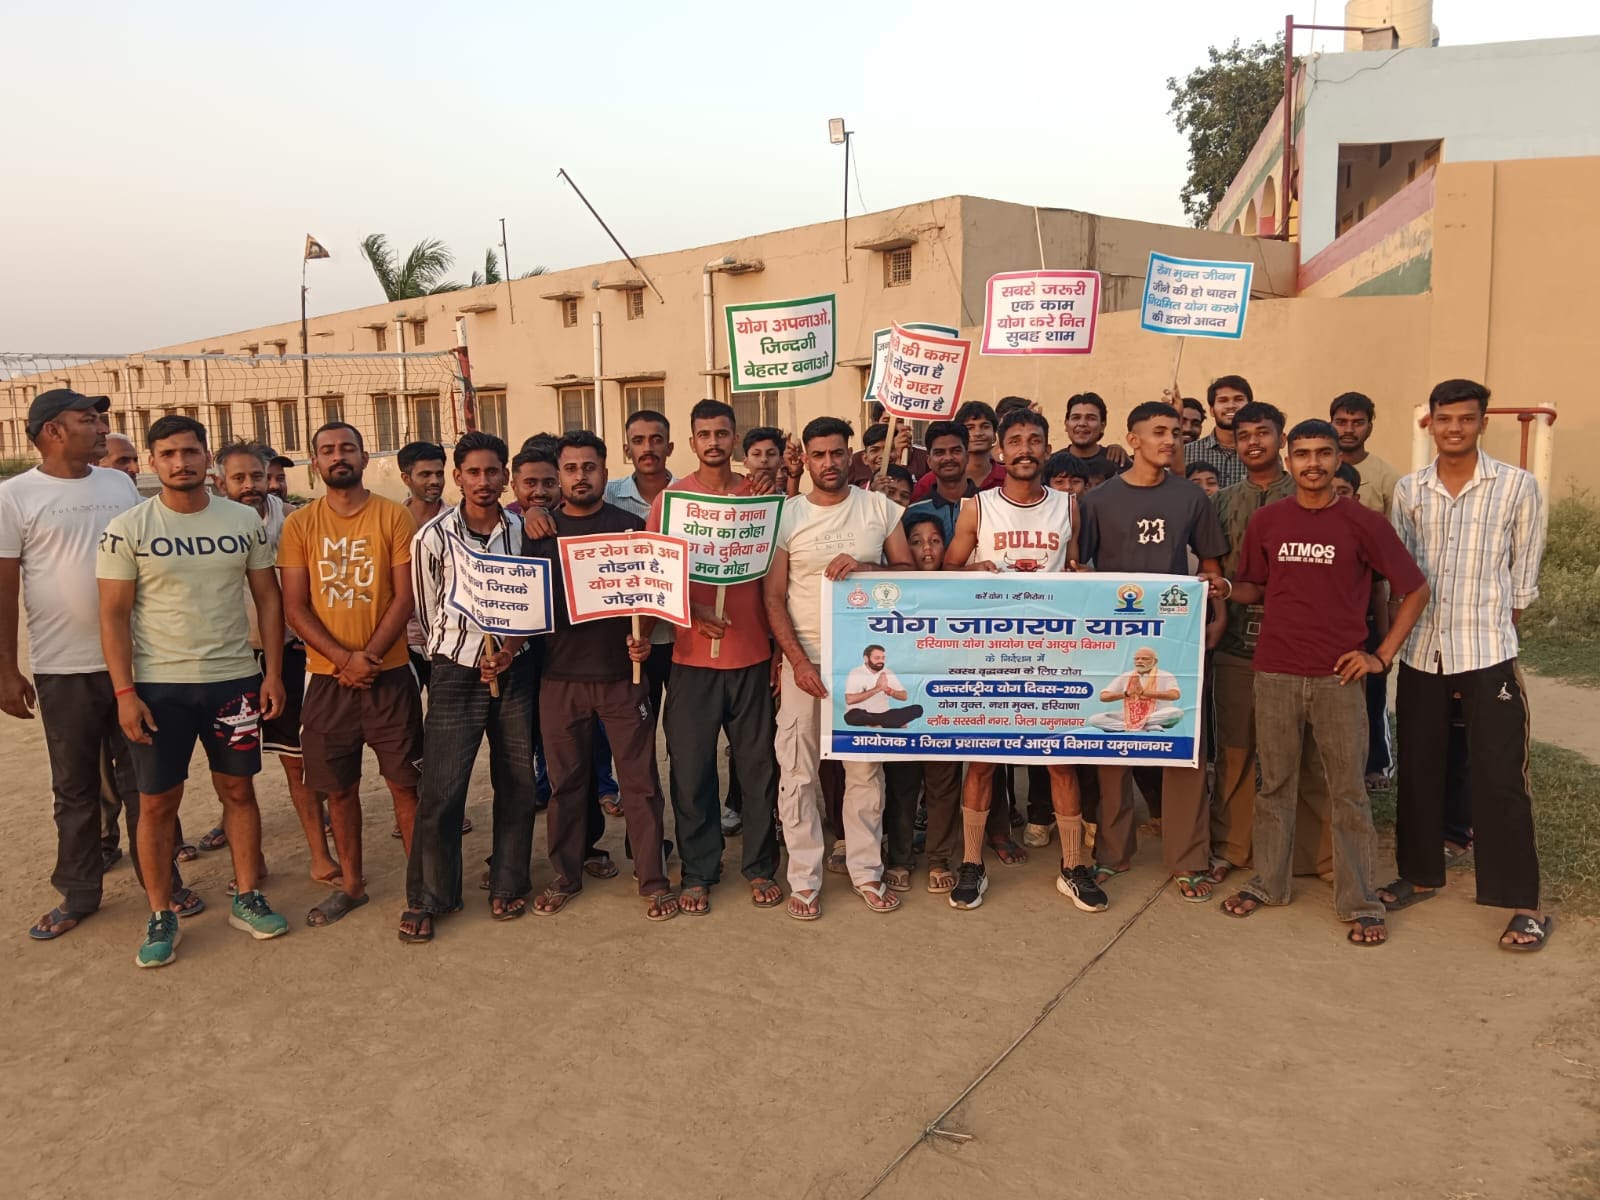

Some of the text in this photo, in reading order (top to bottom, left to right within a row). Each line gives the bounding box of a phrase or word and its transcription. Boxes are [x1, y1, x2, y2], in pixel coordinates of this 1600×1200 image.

[1173, 269, 1200, 282] मुक्त
[1202, 269, 1236, 281] जीवन
[1001, 281, 1086, 297] सबसे जरूरी
[1152, 280, 1170, 293] जीने
[1172, 284, 1188, 296] की
[1191, 286, 1203, 297] हो
[1012, 300, 1075, 312] एक काम
[1184, 301, 1207, 312] योग
[1211, 304, 1239, 314] करने
[736, 308, 830, 334] योग अपनाओ,
[997, 315, 1025, 328] योग
[1059, 313, 1085, 327] नित
[1152, 311, 1227, 327] की डालो आदत
[760, 332, 816, 355] जिन्दगी
[1006, 331, 1075, 348] सुबह शाम
[902, 343, 921, 357] की
[924, 349, 960, 363] कमर
[744, 351, 829, 377] बेहतर बनाओ
[893, 356, 930, 376] तोड़ना
[933, 363, 944, 378] है
[894, 375, 903, 388] से
[907, 380, 943, 394] गहरा
[890, 391, 944, 411] जोड़ना है
[686, 503, 767, 522] विश्व ने माना
[683, 521, 765, 539] योग का लोहा
[1137, 519, 1165, 544] 23
[135, 533, 251, 557] LONDON
[994, 531, 1059, 550] BULLS
[573, 542, 679, 560] हर रोग को अब
[703, 542, 714, 556] ने
[720, 542, 754, 563] दुनिया
[756, 542, 769, 552] का
[1278, 543, 1335, 558] ATMOS
[472, 560, 504, 575] जीवन
[508, 565, 536, 578] जीने
[696, 561, 750, 575] मन मोहा
[487, 579, 528, 594] जिसके
[588, 575, 672, 592] योग से नाता
[474, 594, 530, 611] नतमस्तक
[602, 592, 665, 606] जोड़ना है
[476, 609, 511, 627] विज्ञान
[868, 611, 1164, 636] योग जागरण यात्रा
[916, 637, 1116, 653] हरियाणा योग आयोग एवं आयुष विभाग
[986, 654, 995, 662] के
[1037, 654, 1046, 662] में
[1023, 666, 1034, 674] के
[1038, 666, 1057, 675] लिए
[1060, 666, 1082, 676] योग
[997, 682, 1021, 693] योग
[938, 699, 957, 708] योग
[1042, 700, 1080, 710] हरियाणा
[927, 714, 950, 726] ब्लॉक
[953, 714, 985, 725] सरस्वती
[1015, 714, 1037, 726] जिला
[1040, 718, 1085, 730] यमुनानगर
[852, 734, 907, 747] आयोजक
[920, 735, 952, 748] जिला
[955, 737, 1000, 749] प्रशासन
[1004, 736, 1024, 749] एवं
[1025, 739, 1059, 754] आयुष
[1064, 736, 1103, 750] विभाग
[1107, 740, 1173, 755] यमुनानगर
